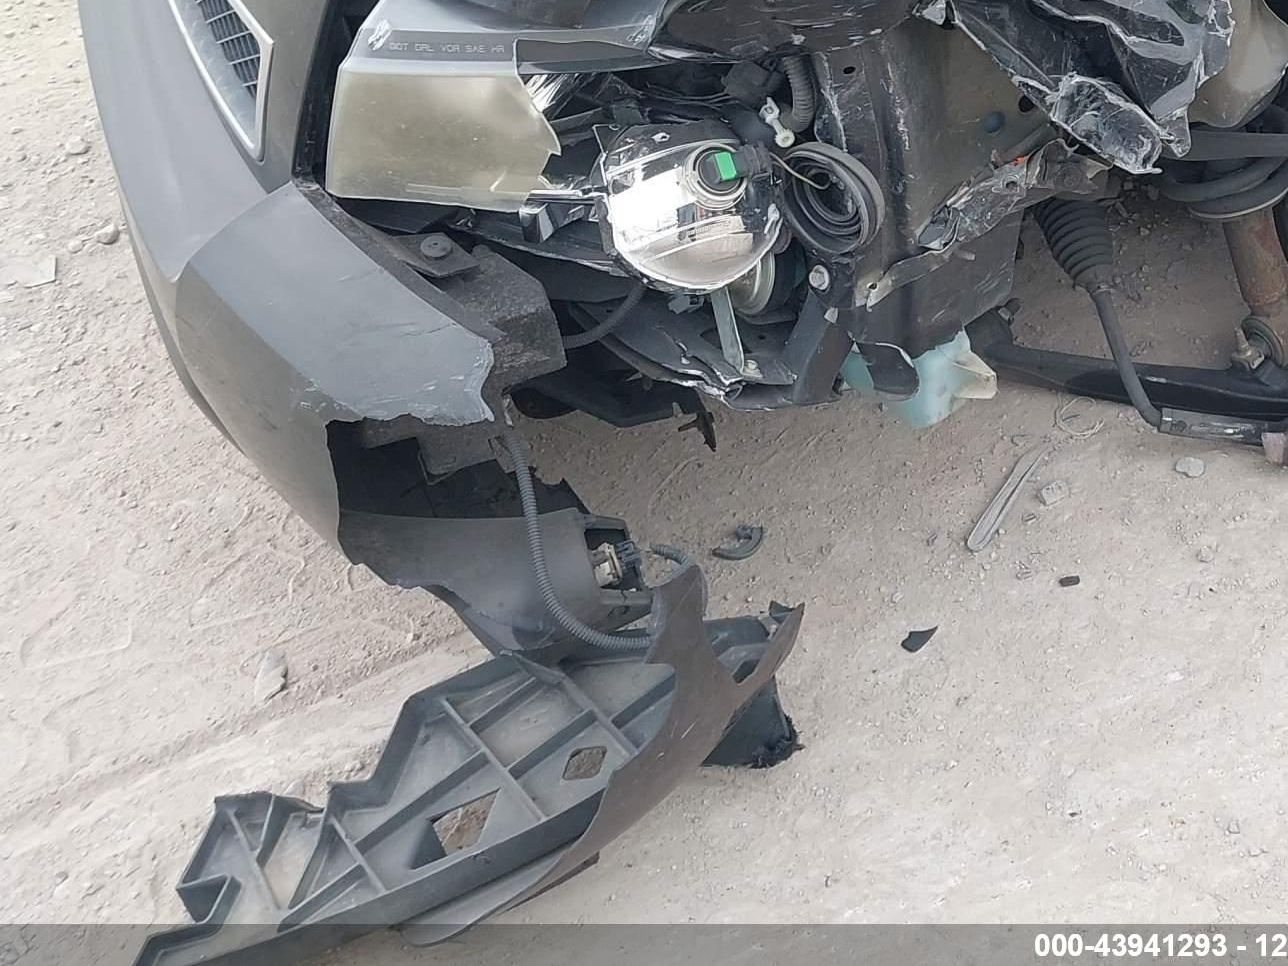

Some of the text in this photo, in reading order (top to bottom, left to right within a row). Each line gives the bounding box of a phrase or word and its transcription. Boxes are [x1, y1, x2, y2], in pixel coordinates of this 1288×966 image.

[389, 42, 505, 54] DOT DRL VOR SAE HR
